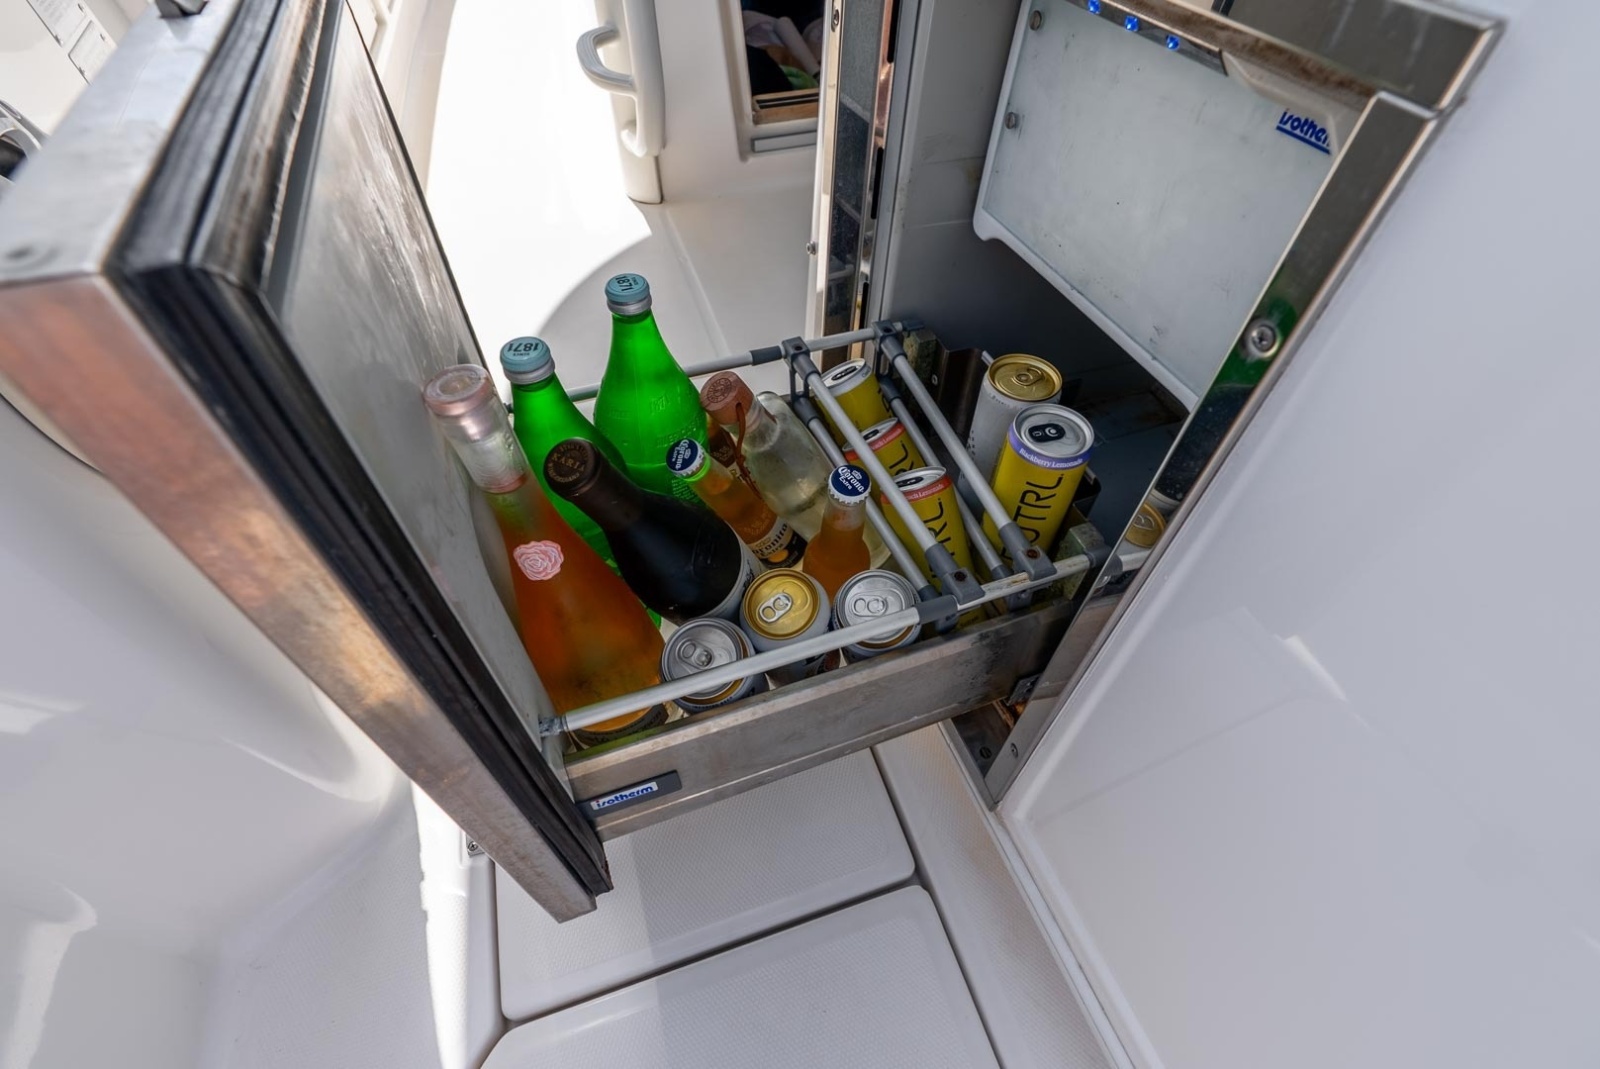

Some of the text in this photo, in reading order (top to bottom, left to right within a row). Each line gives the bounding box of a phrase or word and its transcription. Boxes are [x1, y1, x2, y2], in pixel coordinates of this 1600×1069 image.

[1279, 108, 1330, 148] isother
[615, 275, 635, 292] 1871
[507, 342, 540, 353] 1871
[675, 439, 690, 470] Corona
[1019, 447, 1051, 468] Blackberry
[838, 466, 865, 493] Corona
[839, 475, 853, 490] Extra
[752, 522, 788, 555] oronita
[596, 785, 654, 808] isotherm
